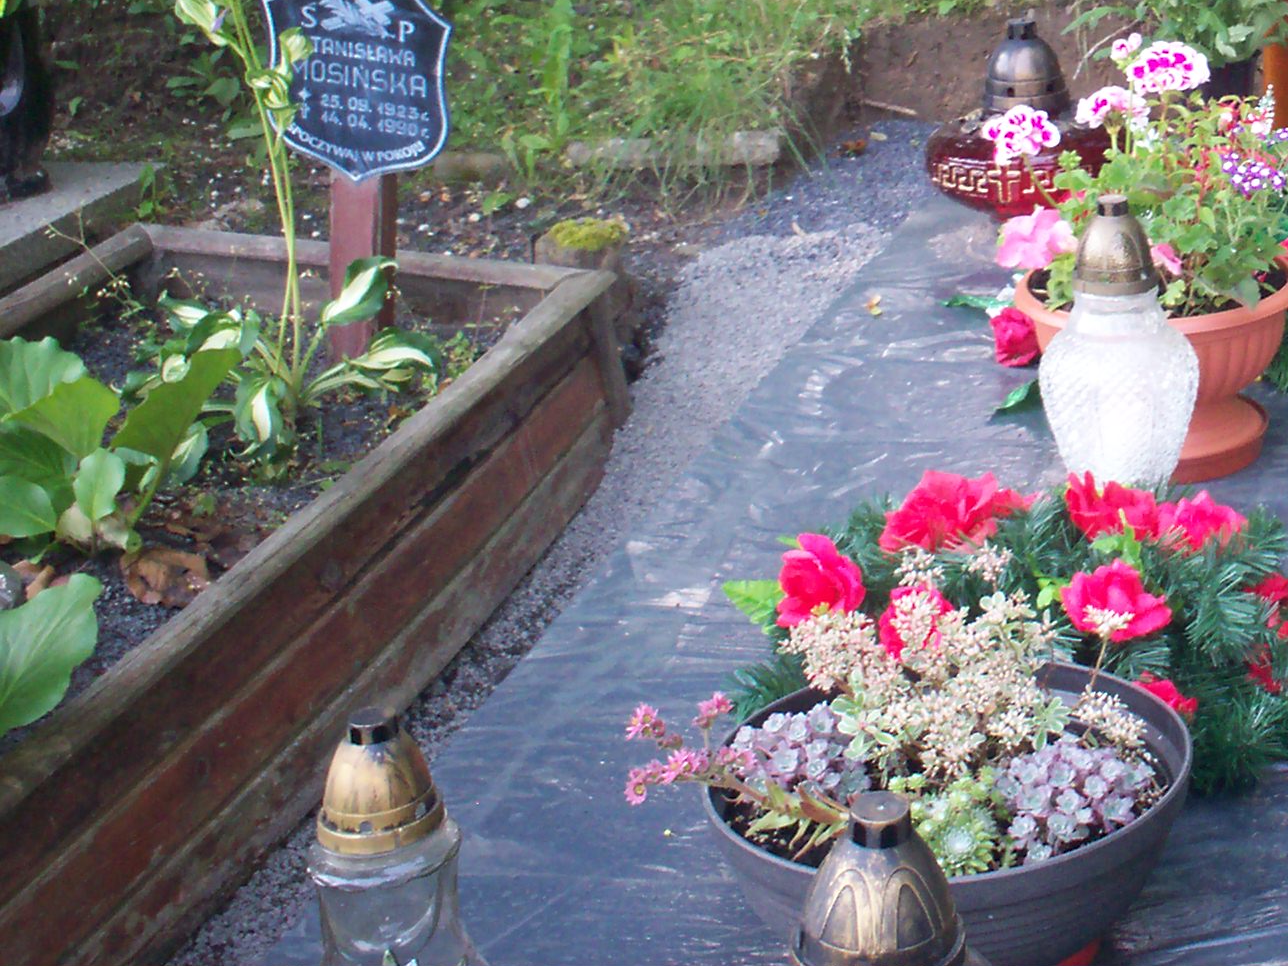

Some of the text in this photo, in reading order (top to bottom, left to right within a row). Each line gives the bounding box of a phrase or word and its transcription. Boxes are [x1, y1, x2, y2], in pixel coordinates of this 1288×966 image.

[399, 20, 415, 42] P
[310, 35, 416, 67] TANISŁAWA
[361, 150, 375, 162] W
